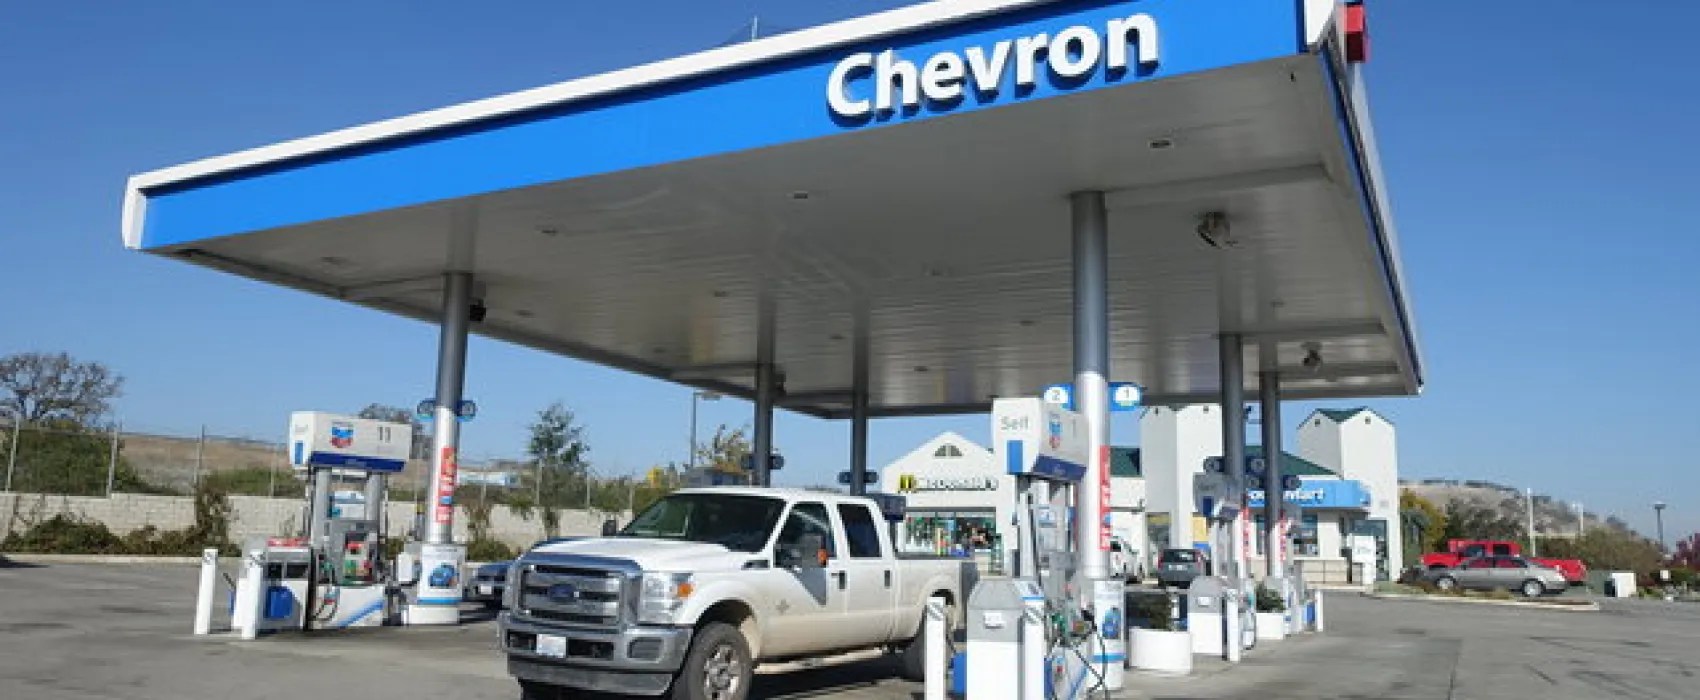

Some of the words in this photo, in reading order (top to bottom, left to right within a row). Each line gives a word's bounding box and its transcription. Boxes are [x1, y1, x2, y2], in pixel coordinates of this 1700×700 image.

[827, 13, 1159, 118] Chevron
[1000, 416, 1029, 431] Self
[376, 426, 392, 443] 11
